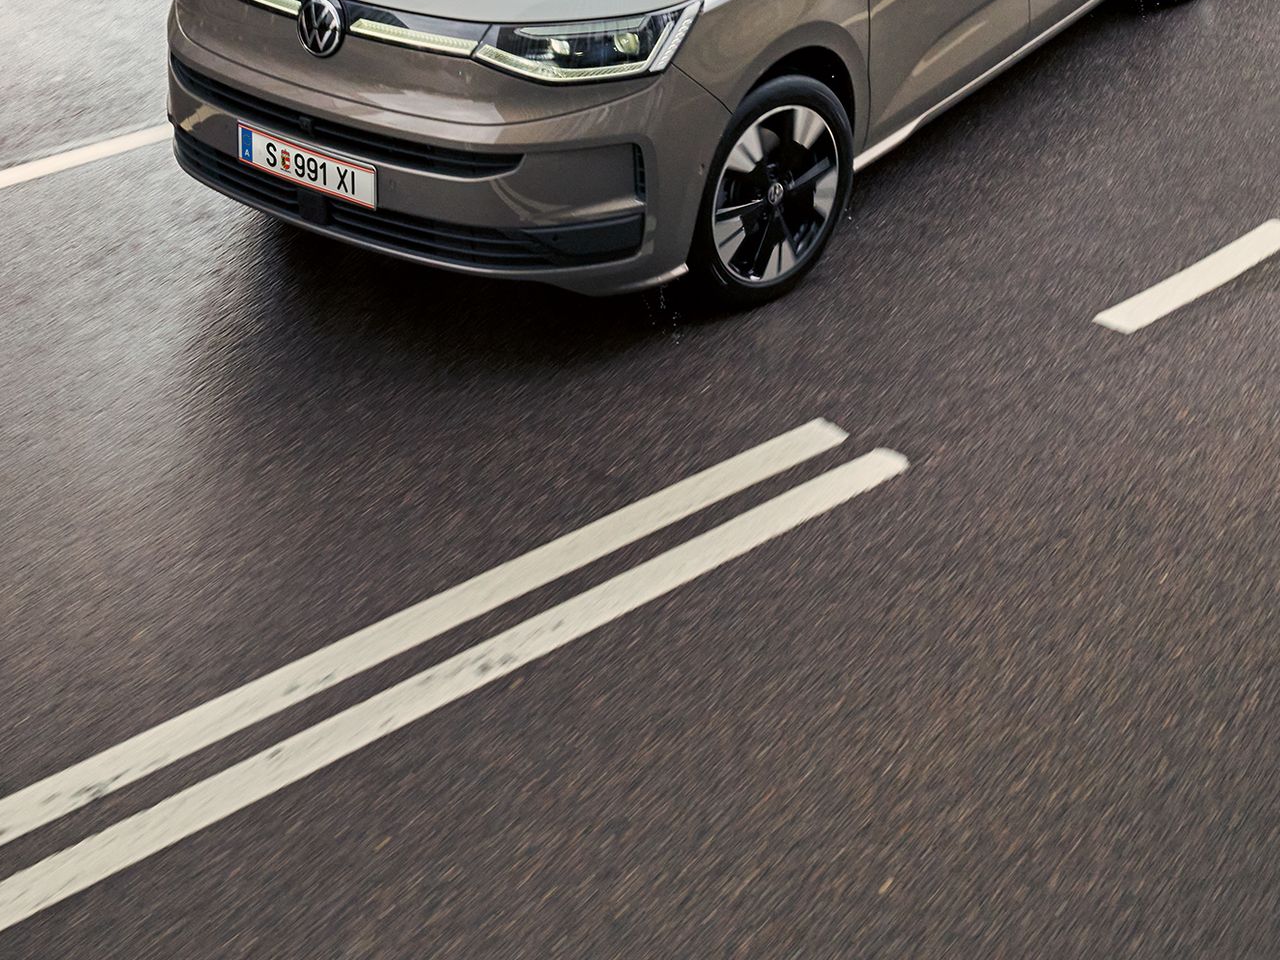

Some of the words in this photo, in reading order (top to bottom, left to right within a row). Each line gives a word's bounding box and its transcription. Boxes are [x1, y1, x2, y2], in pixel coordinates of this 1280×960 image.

[244, 148, 251, 158] A
[265, 142, 278, 168] S
[293, 152, 328, 187] 991
[336, 166, 356, 196] XI
